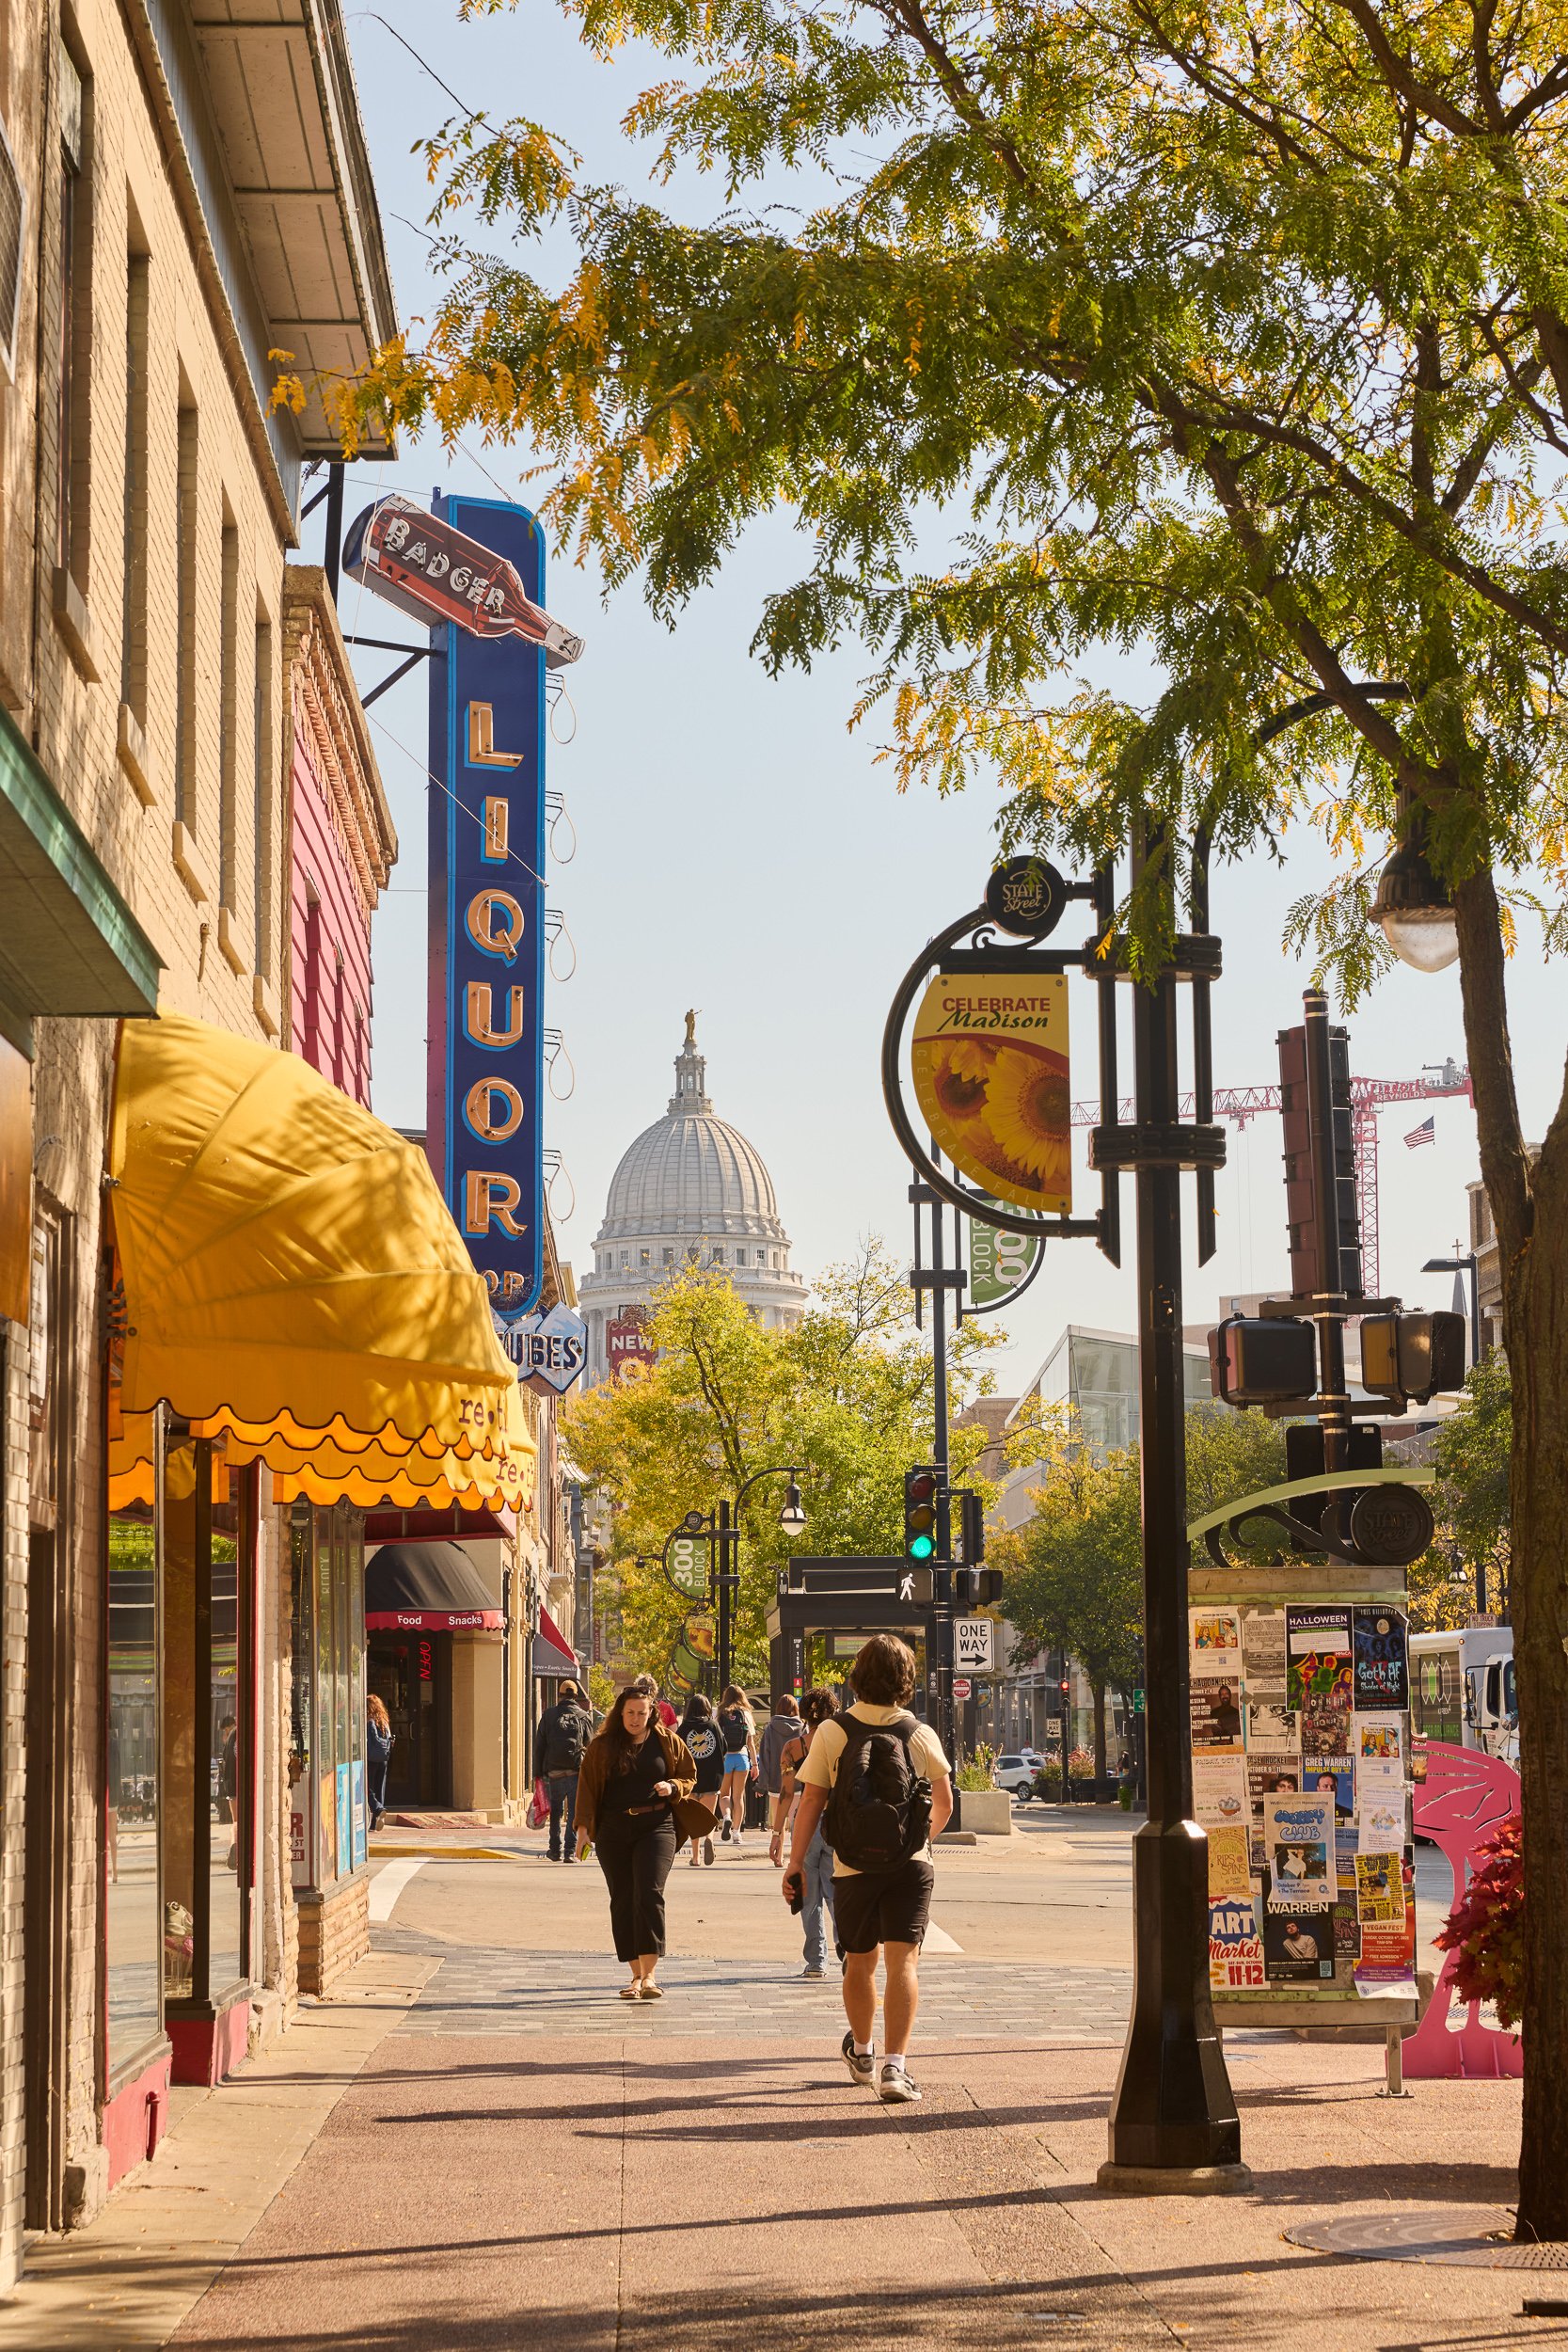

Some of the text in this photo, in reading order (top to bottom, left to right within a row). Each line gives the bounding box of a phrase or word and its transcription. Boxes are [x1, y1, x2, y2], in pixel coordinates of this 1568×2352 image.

[383, 516, 506, 616] BADGER
[1002, 883, 1043, 899] STATE
[1003, 897, 1040, 913] Street
[465, 701, 528, 1237] LIQUOR
[942, 997, 1051, 1012] CELEBRATE
[936, 1008, 1048, 1032] Madison
[1376, 1091, 1426, 1101] REYNOLDS
[917, 1049, 1046, 1208] CELEBRATE FALL
[972, 1216, 991, 1285] BLOCK
[498, 1332, 581, 1370] UBES
[611, 1335, 654, 1351] NEW
[673, 1539, 694, 1587] 300
[694, 1549, 705, 1587] BLOCK
[397, 1614, 483, 1626] Food Snacks
[1290, 1614, 1347, 1626] HALLOWEEN
[959, 1625, 987, 1637] ONE
[959, 1640, 988, 1651] WAY
[420, 1641, 432, 1679] OPEN
[1358, 1662, 1386, 1681] Goth
[1361, 1681, 1379, 1691] Shades
[1306, 1757, 1352, 1767] GREG WARREN
[1280, 1826, 1321, 1841] CLUB
[1222, 1864, 1246, 1875] SPINS
[1267, 1902, 1329, 1914] WARREN
[1212, 1912, 1253, 1934] ART
[1209, 1938, 1260, 1960] Market
[1228, 1965, 1263, 1985] 11-12
